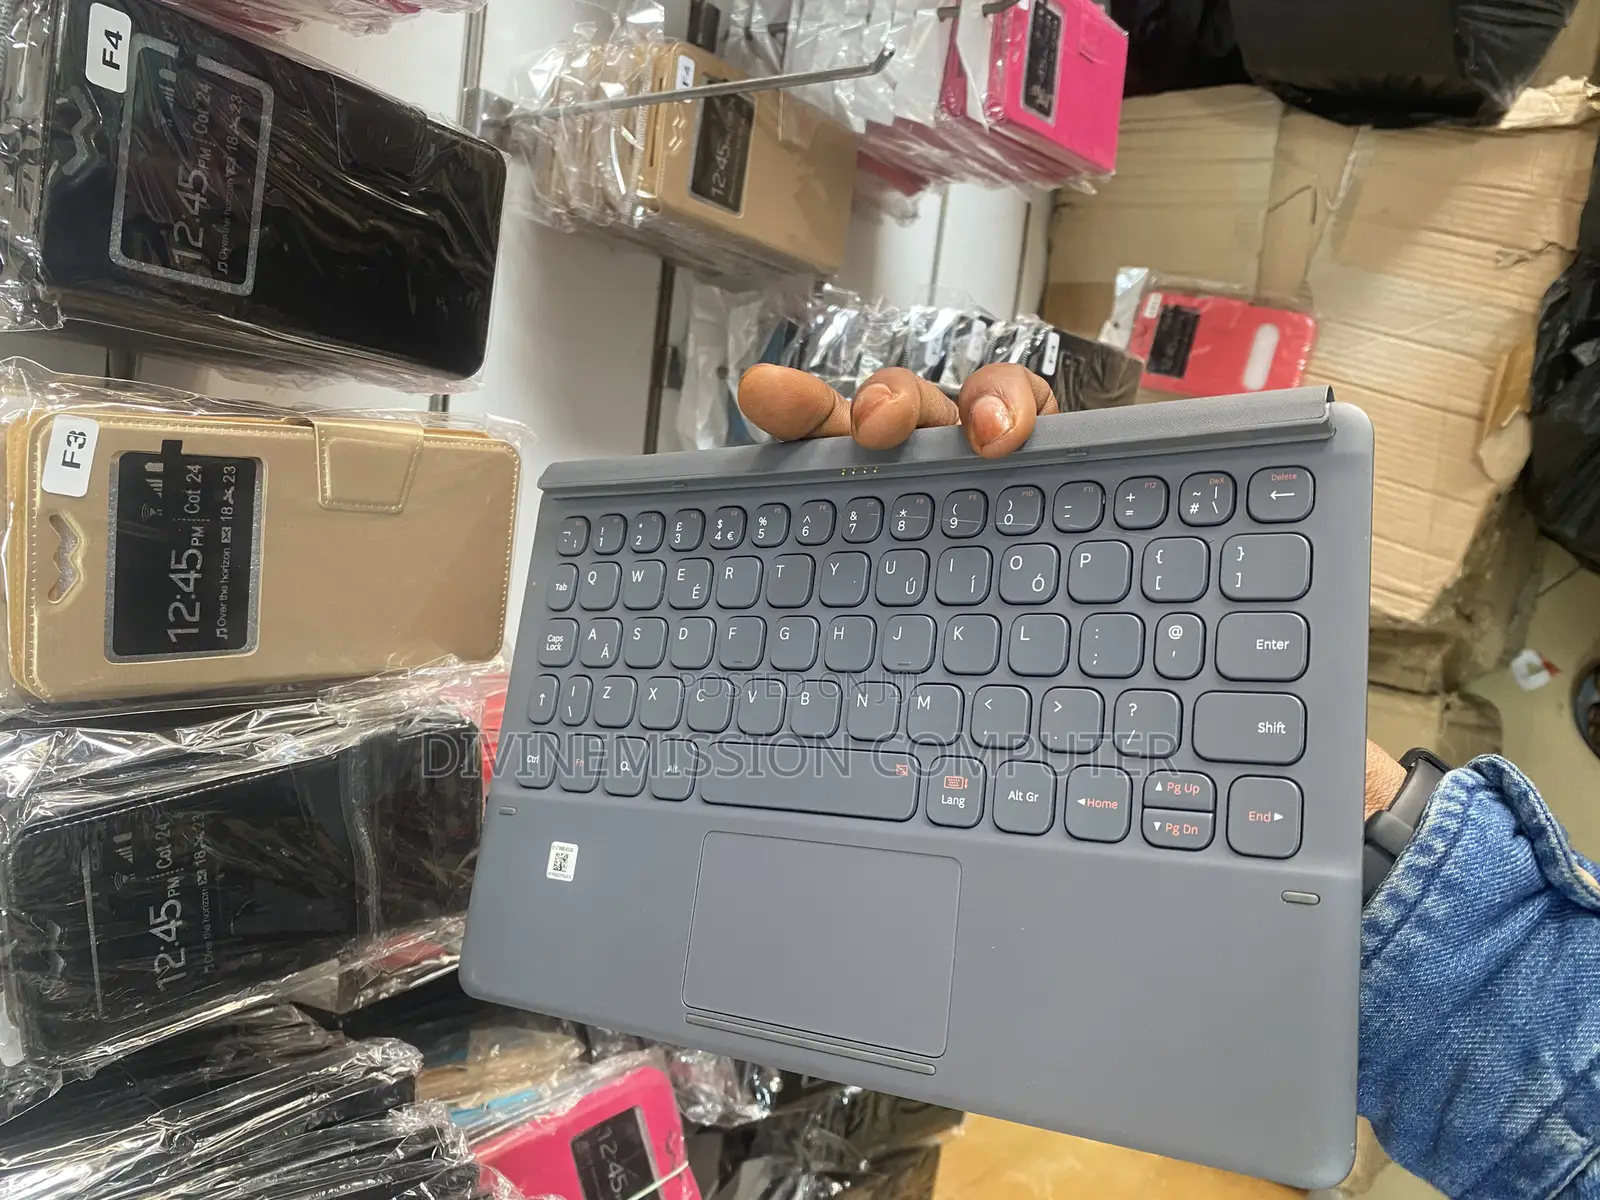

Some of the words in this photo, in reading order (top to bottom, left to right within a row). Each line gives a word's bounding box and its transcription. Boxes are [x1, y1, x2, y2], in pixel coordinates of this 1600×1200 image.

[103, 30, 122, 70] F4
[199, 83, 212, 107] 24
[227, 135, 239, 152] 18
[198, 150, 211, 170] PM
[171, 164, 210, 264] 12:45
[62, 430, 87, 469] F3
[186, 464, 203, 483] 24
[223, 465, 237, 484] 23
[1271, 473, 1298, 482] Delete
[1209, 477, 1225, 485] DeX
[1126, 492, 1136, 503] +
[220, 506, 234, 522] 18
[1189, 502, 1200, 514] #
[758, 516, 768, 526] %
[850, 511, 858, 520] &
[676, 522, 682, 532] £
[716, 518, 724, 530] $
[850, 523, 857, 534] 7
[898, 520, 906, 532] 8
[950, 517, 958, 530] 9
[191, 526, 205, 547] PM
[714, 530, 722, 541] 4
[726, 530, 735, 541] €
[758, 528, 765, 539] 5
[802, 526, 810, 537] 6
[636, 536, 642, 546] 2
[674, 534, 682, 544] 3
[1079, 553, 1092, 568] P
[1155, 549, 1164, 565] {
[1236, 546, 1245, 562] }
[220, 547, 231, 580] horizon
[830, 562, 840, 576] Y
[885, 560, 897, 575] U
[949, 558, 954, 573] I
[1009, 555, 1023, 571] O
[587, 570, 597, 585] Q
[632, 570, 644, 582] W
[677, 568, 686, 582] E
[725, 566, 734, 580] R
[776, 564, 786, 578] T
[905, 577, 917, 595] Ú
[970, 575, 976, 594] Í
[1031, 573, 1046, 593] Ó
[1155, 575, 1162, 591] [
[1235, 572, 1242, 588] ]
[219, 580, 229, 602] the
[555, 583, 568, 592] Tab
[692, 583, 701, 600] É
[166, 548, 203, 643] 12:45
[217, 602, 228, 627] Over
[547, 634, 564, 644] Caps
[588, 628, 598, 641] A
[632, 627, 642, 641] S
[678, 628, 688, 641] D
[728, 627, 737, 640] F
[780, 626, 790, 640] G
[833, 626, 845, 640] H
[892, 626, 903, 641] J
[953, 626, 964, 641] K
[1020, 626, 1031, 641] L
[1168, 624, 1184, 640] @
[546, 643, 562, 652] Lock
[600, 643, 610, 659] Á
[1255, 638, 1290, 650] Enter
[603, 686, 612, 700] Z
[648, 688, 658, 701] X
[696, 689, 706, 702] C
[748, 690, 758, 704] V
[800, 692, 810, 706] B
[856, 694, 868, 708] N
[917, 695, 931, 710] M
[1128, 702, 1138, 717] ?
[1257, 721, 1287, 735] Shift
[526, 754, 540, 764] Ctrl
[576, 758, 585, 766] Fn
[666, 765, 680, 774] Alt
[1166, 781, 1181, 796] Pg
[1184, 782, 1201, 797] Up
[941, 793, 966, 809] Lang
[1008, 790, 1023, 802] Alt
[1026, 792, 1039, 803] Gr
[1087, 797, 1119, 810] Home
[1248, 810, 1272, 823] End
[192, 813, 205, 835] 23
[1165, 822, 1181, 837] Pg
[1183, 823, 1199, 835] Dn
[154, 822, 172, 844] 24
[193, 849, 207, 867] 18
[167, 876, 181, 899] PM
[149, 899, 187, 992] 12:45
